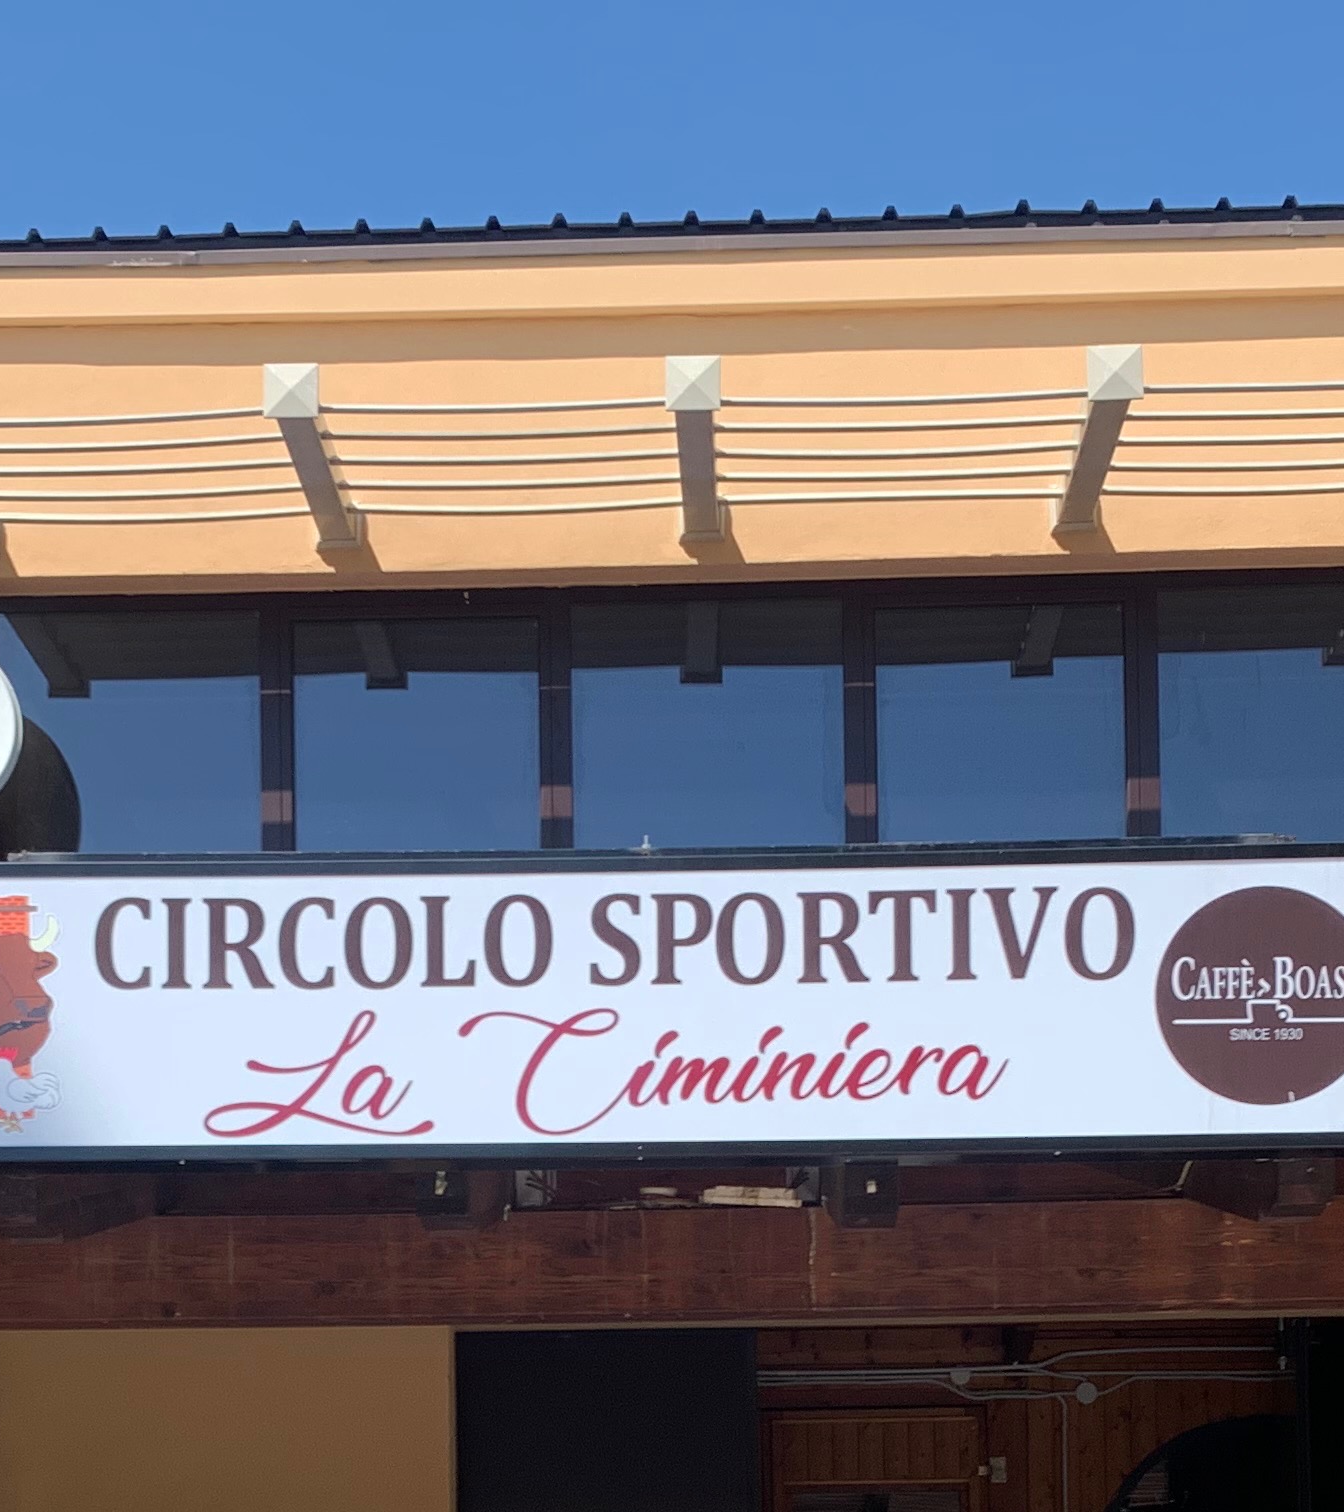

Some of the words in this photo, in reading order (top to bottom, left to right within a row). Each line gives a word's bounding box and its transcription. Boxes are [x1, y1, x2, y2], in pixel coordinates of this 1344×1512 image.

[93, 893, 554, 991] CIRCOLO
[588, 885, 1137, 987] SPORTIVO
[1171, 956, 1256, 1001] CAFFÈ
[1229, 1027, 1271, 1041] SINCE
[1273, 1027, 1304, 1041] 1930
[203, 1009, 435, 1138] La
[458, 1006, 1010, 1136] Ciminiera
